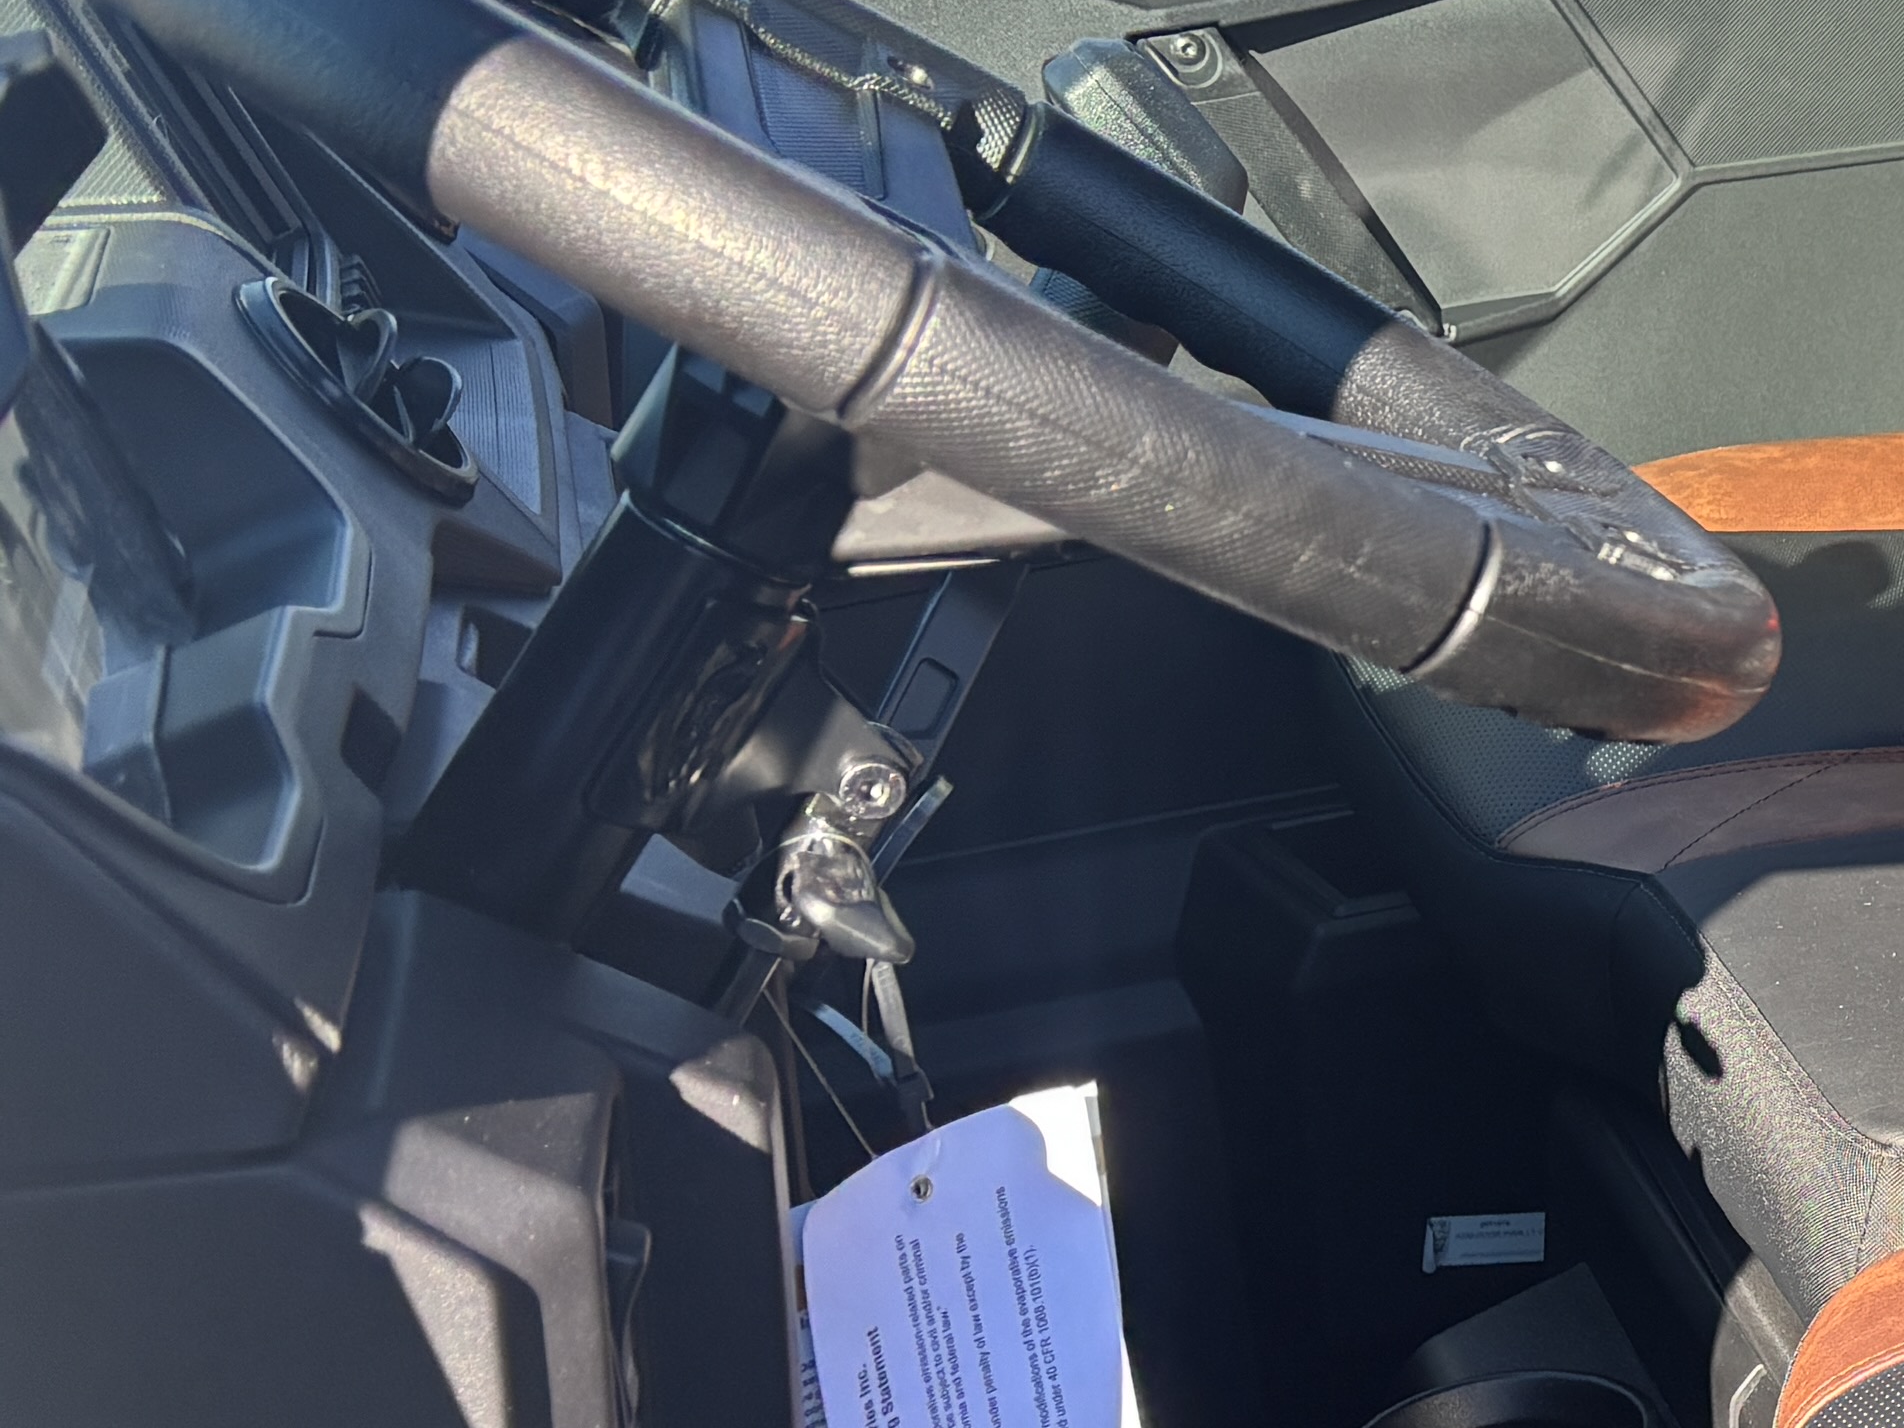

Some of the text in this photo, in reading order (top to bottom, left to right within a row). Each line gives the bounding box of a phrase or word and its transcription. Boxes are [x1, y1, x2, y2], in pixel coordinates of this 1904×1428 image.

[993, 1186, 1015, 1245] emissions
[953, 1232, 966, 1253] the
[958, 1255, 972, 1270] by
[962, 1271, 979, 1311] except
[1005, 1247, 1029, 1316] evaporative
[970, 1313, 983, 1335] law
[1019, 1317, 1033, 1337] the
[974, 1336, 985, 1349] of
[1023, 1339, 1035, 1351] of
[1040, 1336, 1055, 1364] CFR
[854, 1363, 871, 1397] Inc.
[866, 1325, 894, 1413] Statement
[977, 1350, 996, 1394] penalty
[1046, 1365, 1058, 1381] 40
[1026, 1352, 1050, 1428] modifications
[1050, 1383, 1065, 1416] under
[987, 1396, 1001, 1428] under
